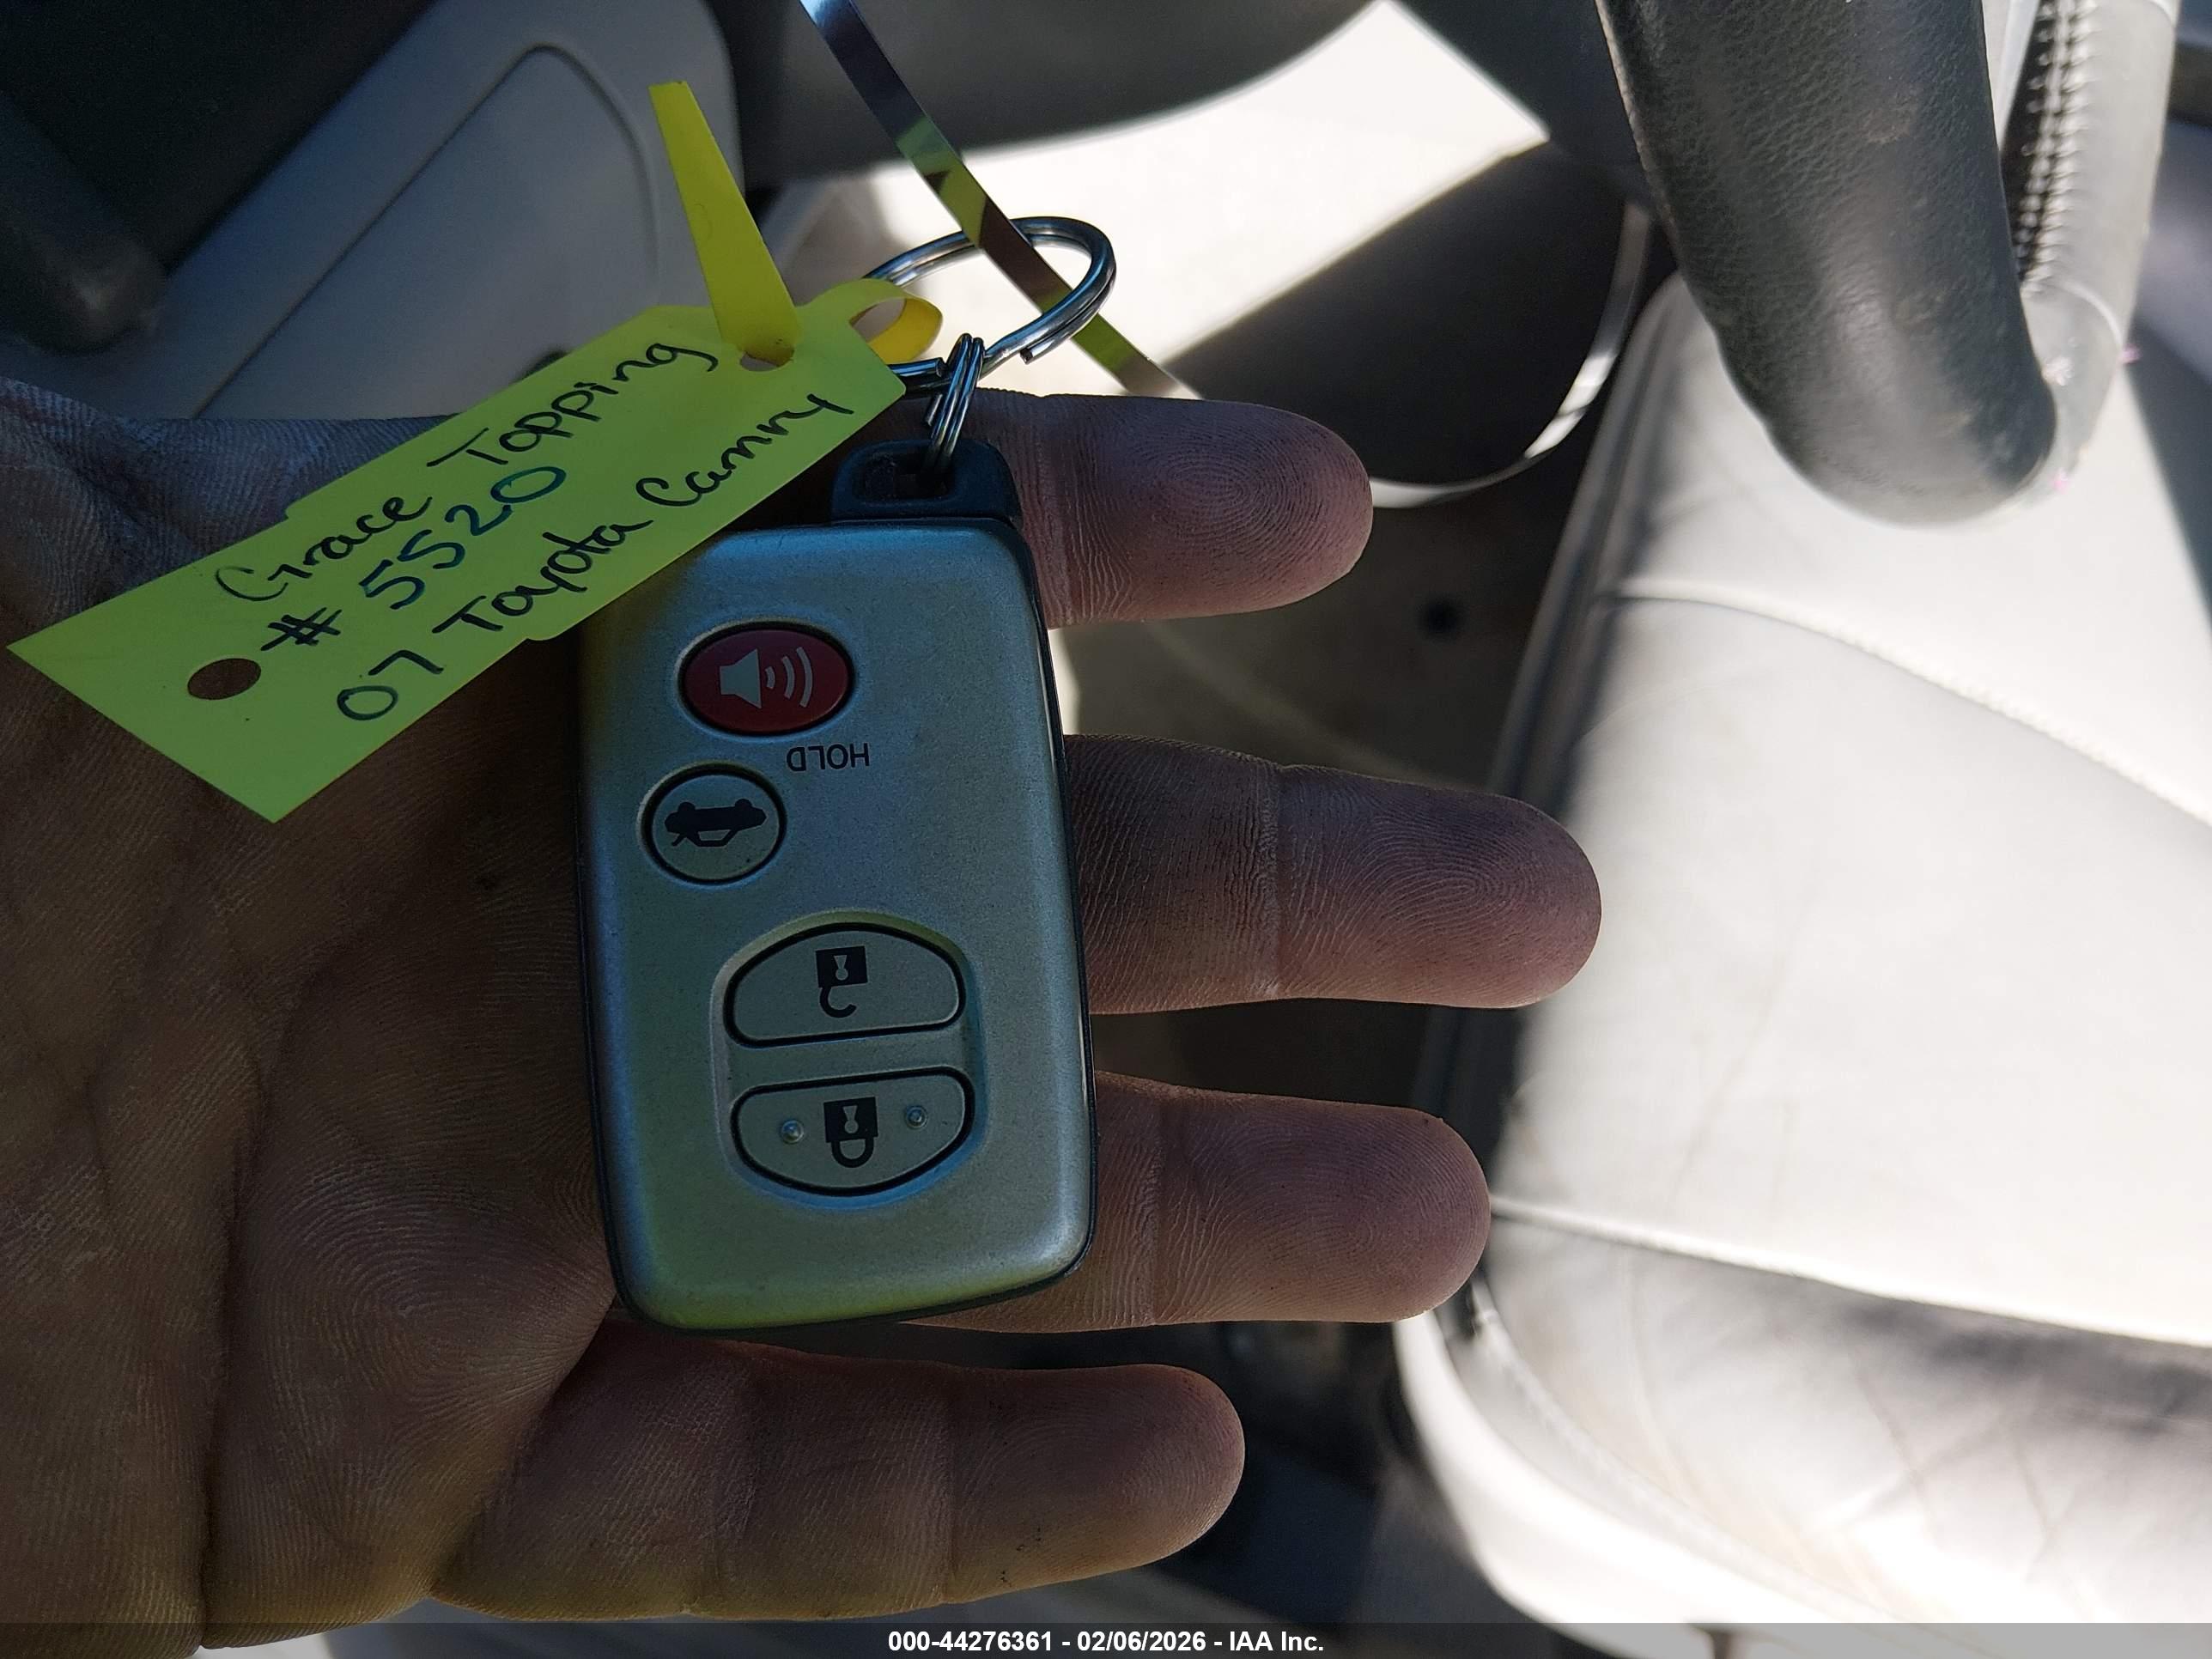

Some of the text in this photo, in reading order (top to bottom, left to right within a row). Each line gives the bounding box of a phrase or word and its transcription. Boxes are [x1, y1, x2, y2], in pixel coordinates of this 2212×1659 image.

[216, 343, 719, 601] Grace Topping
[260, 466, 566, 652] # 5520
[337, 649, 444, 720] 07
[432, 520, 653, 634] Toyota
[787, 743, 870, 772] HOLD
